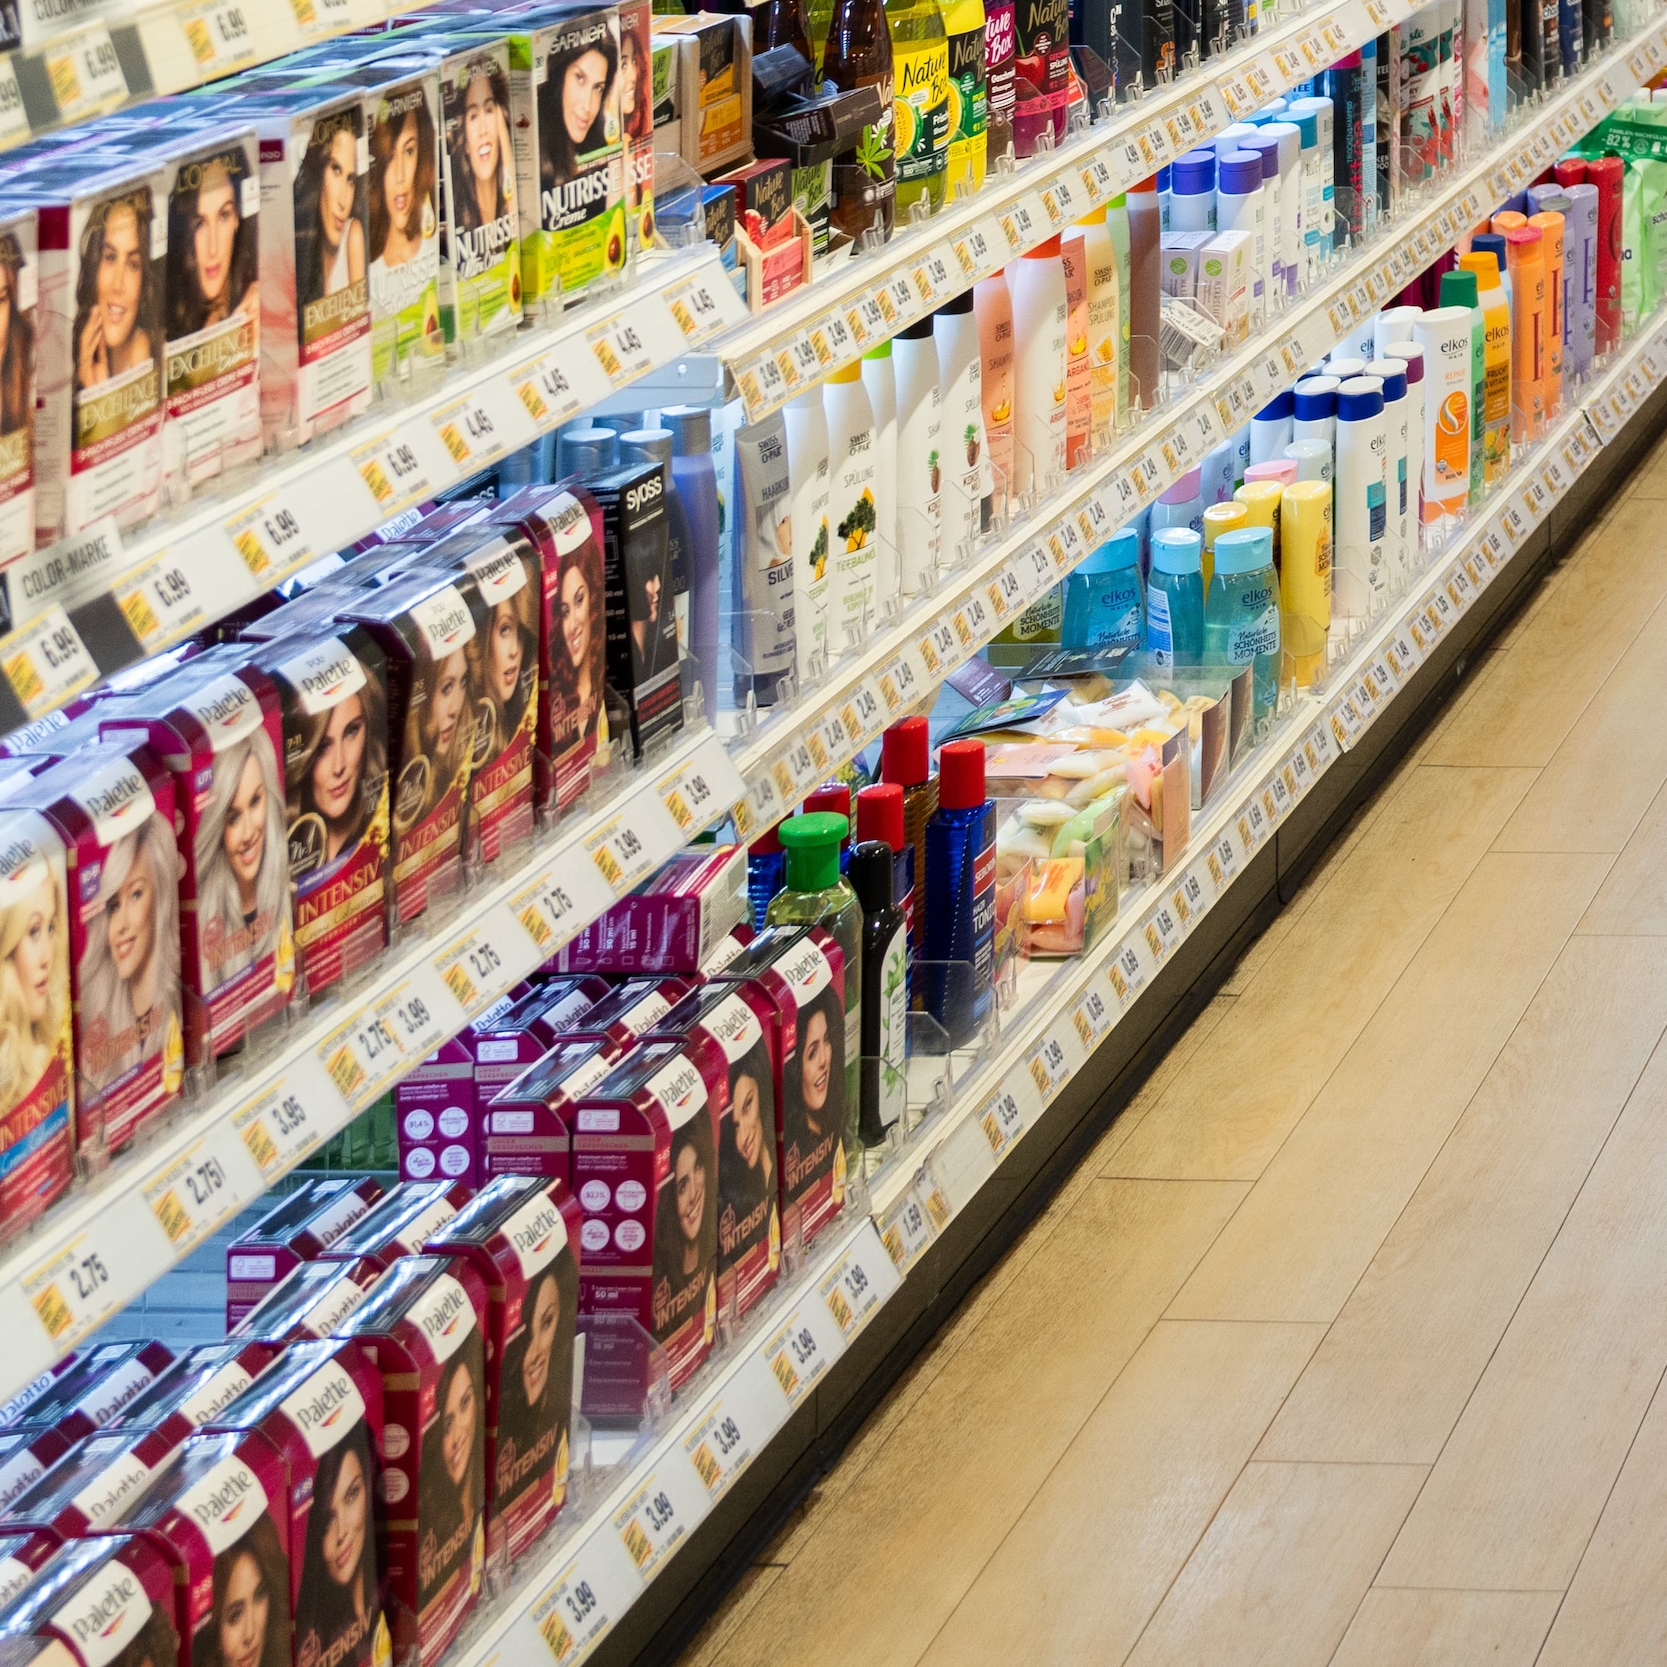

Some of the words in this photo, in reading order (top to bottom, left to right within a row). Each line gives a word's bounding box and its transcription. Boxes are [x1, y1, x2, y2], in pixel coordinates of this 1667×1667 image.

[550, 22, 607, 55] GARNIER
[541, 163, 620, 219] NUTRISSE
[548, 205, 588, 231] Crème
[689, 288, 715, 317] 4.45
[615, 326, 642, 358] 4.45
[1441, 337, 1468, 353] elkos
[1485, 325, 1510, 342] elkos
[544, 367, 570, 399] 4.45
[388, 445, 419, 477] 6.99
[626, 475, 663, 512] syoss
[264, 508, 300, 546] 6.99
[155, 568, 191, 607] 6.99
[1101, 588, 1136, 605] elkos
[1242, 587, 1273, 604] elkos
[40, 624, 79, 668] 6.99
[1233, 640, 1277, 660] MOMENTE
[302, 655, 355, 694] Palette
[544, 885, 574, 922] 2.75
[471, 943, 502, 978] 2.75
[784, 951, 823, 988] Palette
[713, 1004, 752, 1043] Palette
[659, 1067, 699, 1108] Palette
[272, 1092, 307, 1134] 3.95
[786, 1132, 834, 1190] INTENSIV
[721, 1195, 769, 1254] INTENSIV
[69, 1253, 109, 1299] 2.75
[790, 1330, 818, 1369] 3.99
[297, 1376, 352, 1431] Palette
[712, 1415, 743, 1455] 3.99
[195, 1468, 254, 1527] Palette
[643, 1490, 674, 1531] 3.99
[566, 1581, 597, 1620] 3.99
